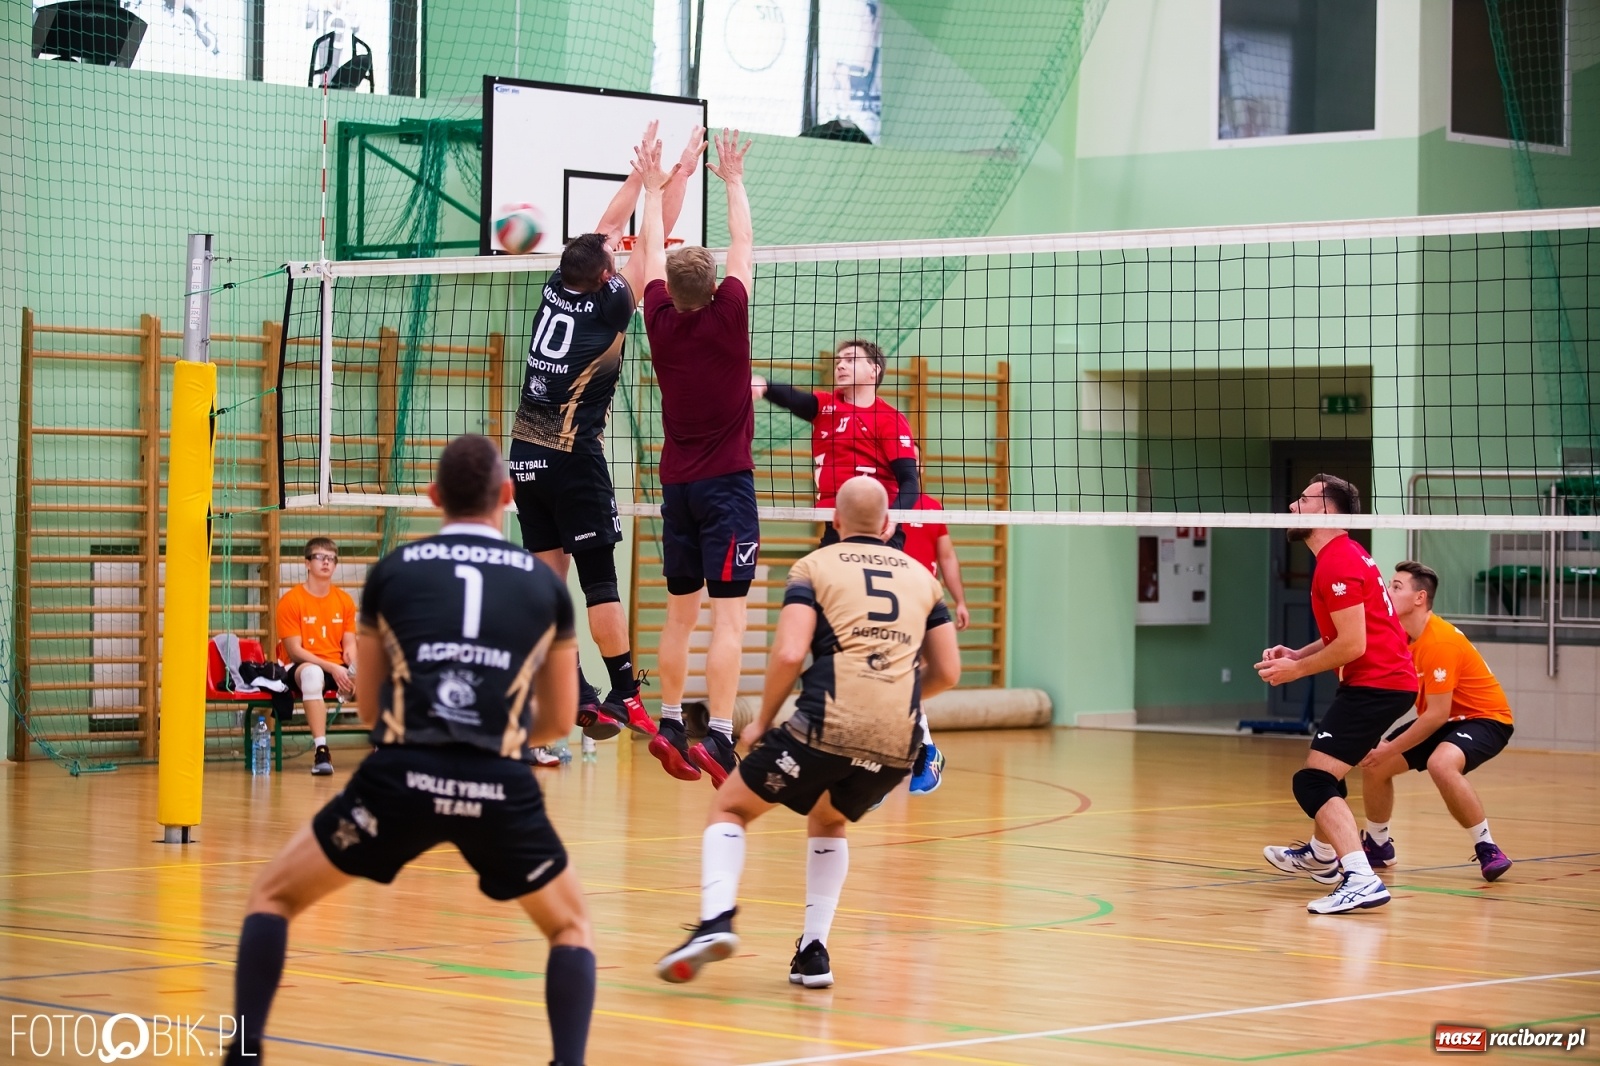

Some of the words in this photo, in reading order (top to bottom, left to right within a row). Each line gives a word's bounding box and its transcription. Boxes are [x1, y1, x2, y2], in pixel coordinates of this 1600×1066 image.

[532, 304, 575, 359] 10
[515, 472, 536, 482] TEAM
[611, 515, 622, 533] 10
[574, 531, 597, 542] AGROTIM
[403, 543, 534, 571] KOŁODZIEJ
[838, 552, 910, 569] GONSIOR
[455, 564, 484, 640] 1
[862, 567, 900, 623] 5
[321, 625, 327, 639] 1
[851, 626, 912, 647] AGROTIM
[416, 643, 512, 670] AGROTIM
[850, 757, 882, 773] TEAM
[406, 770, 507, 801] VOLLEYBALL
[432, 797, 483, 818] TEAM
